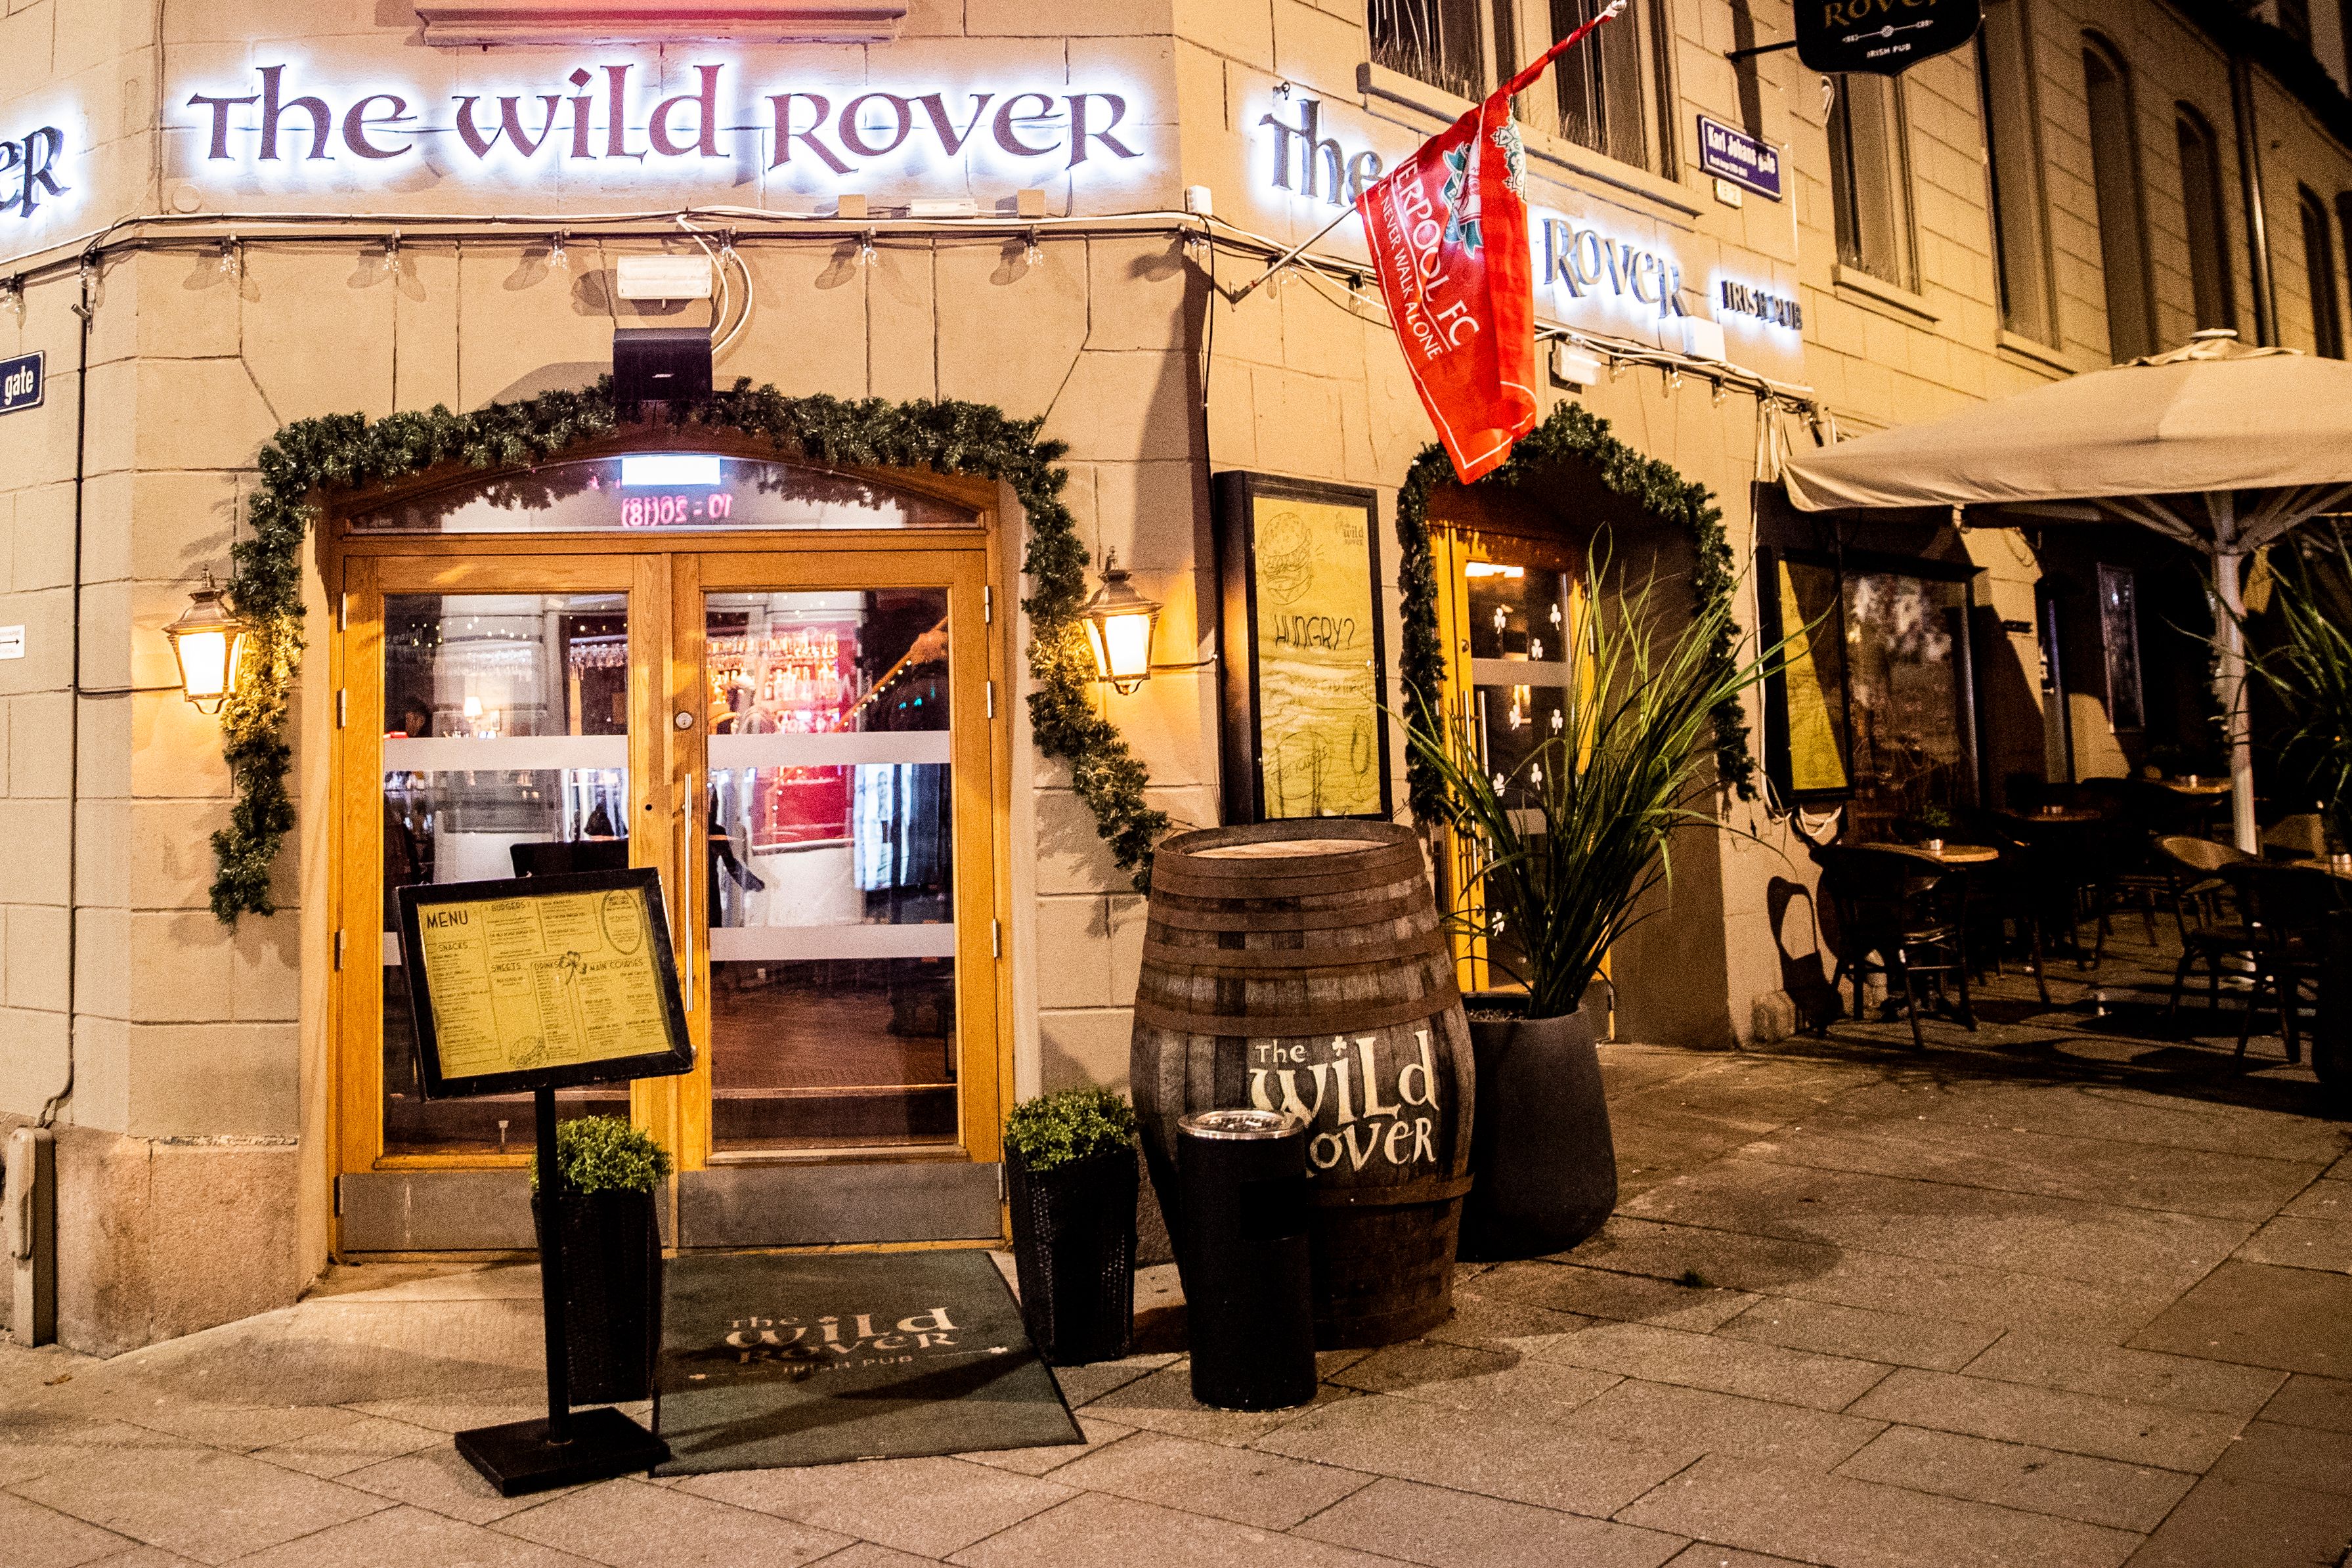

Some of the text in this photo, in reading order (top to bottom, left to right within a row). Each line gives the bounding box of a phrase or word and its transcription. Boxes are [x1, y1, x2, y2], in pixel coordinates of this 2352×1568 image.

[1866, 43, 1911, 58] IRISH PUB
[1380, 195, 1403, 250] NEVER
[1394, 248, 1414, 299] WALK
[1405, 301, 1443, 360] ALONE
[1437, 299, 1480, 347] FC
[4, 365, 34, 406] gate
[1274, 613, 1356, 651] HUNGRY?
[426, 910, 468, 929] MENU
[438, 942, 468, 951] SNACKS
[492, 963, 521, 972] SWEETS
[862, 1355, 913, 1367] PUB
